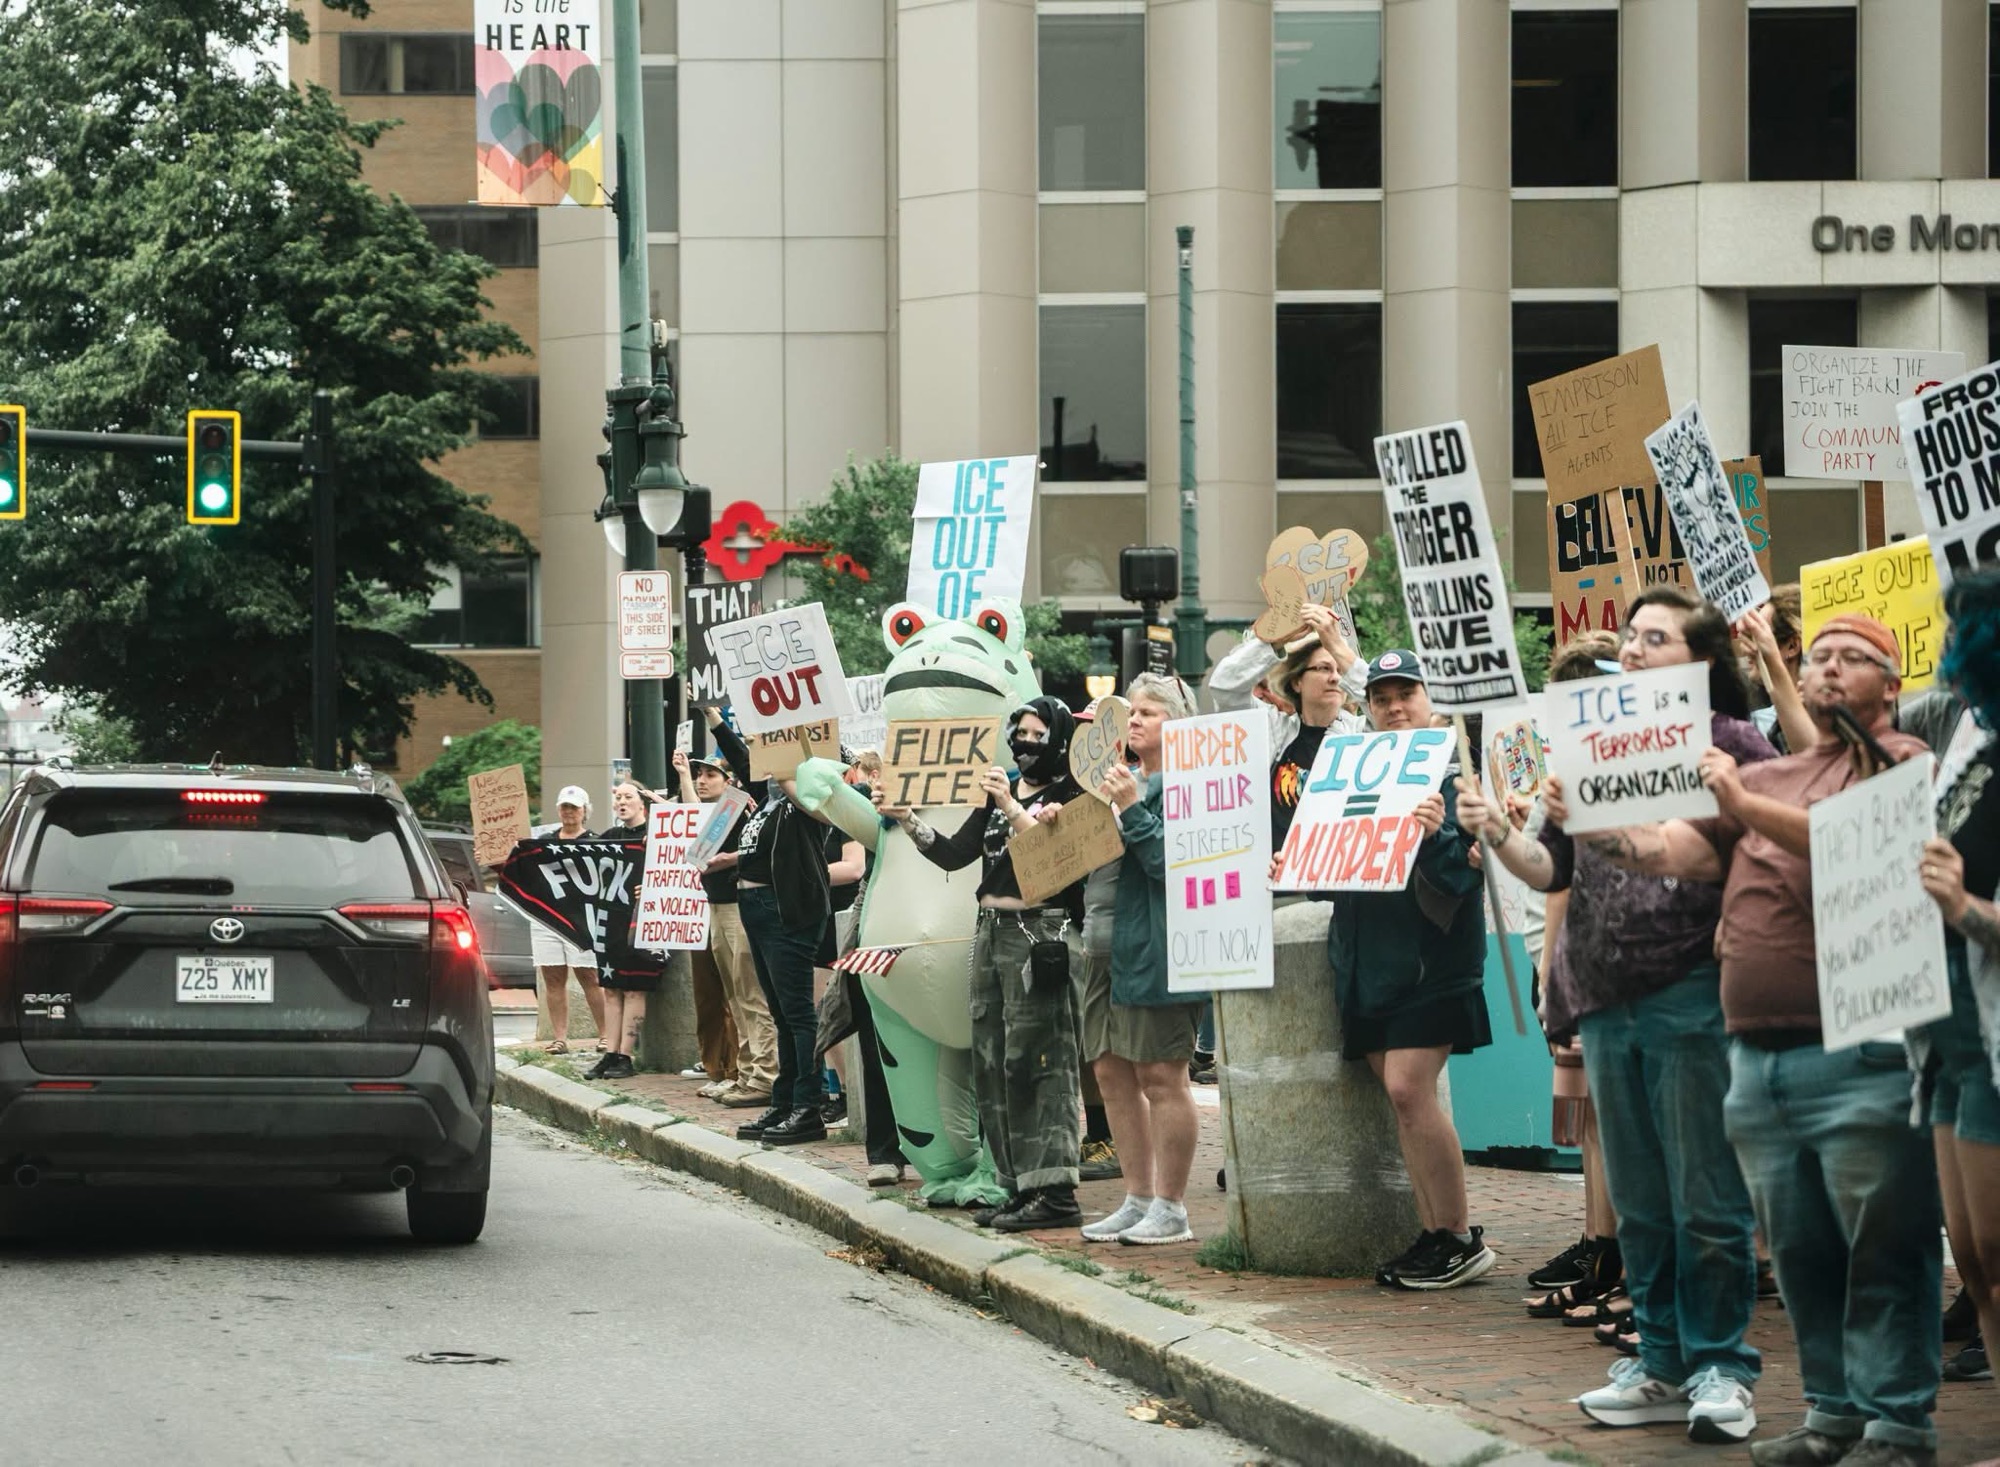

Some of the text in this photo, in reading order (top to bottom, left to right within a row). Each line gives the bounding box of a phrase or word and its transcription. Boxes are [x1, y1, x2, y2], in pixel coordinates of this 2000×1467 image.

[486, 23, 591, 51] HEART
[1812, 214, 1896, 253] One
[1792, 352, 1927, 378] ORGANIZE THE
[1535, 359, 1640, 418] IMPRISON
[1799, 375, 1900, 397] FIGHT BACK!
[1573, 403, 1617, 438] ICE
[1791, 401, 1859, 419] JOIN THE
[1802, 422, 1901, 449] COMMUN
[1914, 393, 2000, 478] HOUS
[1567, 441, 1614, 477] AGENTS
[1823, 450, 1876, 472] PARTY
[953, 459, 1009, 516] ICE
[1400, 485, 1429, 507] THE
[1924, 470, 1970, 528] TO
[1555, 472, 1761, 572] BELEV UR
[932, 515, 1007, 570] OUT
[634, 577, 654, 594] NO
[1307, 566, 1358, 607] UT!
[1645, 561, 1684, 586] NOT
[1810, 550, 1933, 611] ICE OUT
[688, 581, 752, 625] THAT
[937, 569, 987, 620] OF
[1721, 583, 1754, 617] GREAT
[623, 624, 667, 636] OF STREET
[625, 612, 665, 624] THIS SIDE
[1419, 614, 1493, 651] GAVE
[1560, 594, 1620, 645] MA
[720, 620, 816, 680] ICE
[1421, 648, 1509, 677] TH GUN
[691, 663, 728, 701] MU
[751, 664, 823, 717] OUT
[855, 678, 884, 713] OU
[1569, 682, 1638, 729] ICE
[1653, 689, 1670, 711] is
[891, 726, 992, 766] FUCK
[1074, 706, 1119, 778] ICE
[1164, 722, 1249, 772] MURDER
[1581, 722, 1694, 765] TERRORIST
[1309, 730, 1447, 793] ICE
[893, 769, 974, 807] ICE
[1166, 772, 1254, 821] ON OUR
[655, 809, 700, 839] ICE
[1175, 822, 1255, 861] STREETS
[1815, 778, 1925, 873] THEY BLAME
[657, 844, 686, 865] HUM
[1273, 815, 1421, 887] MURDER
[538, 855, 634, 905] FUCK
[1185, 872, 1240, 908] ICE
[660, 896, 708, 918] VIOLENT
[1888, 896, 1936, 946] BLAME
[641, 920, 705, 944] PEDOPHILES
[1172, 924, 1262, 968] OUT NOW
[181, 967, 268, 990] Z25 XMY
[214, 958, 246, 967] Québec
[392, 998, 411, 1007] LE
